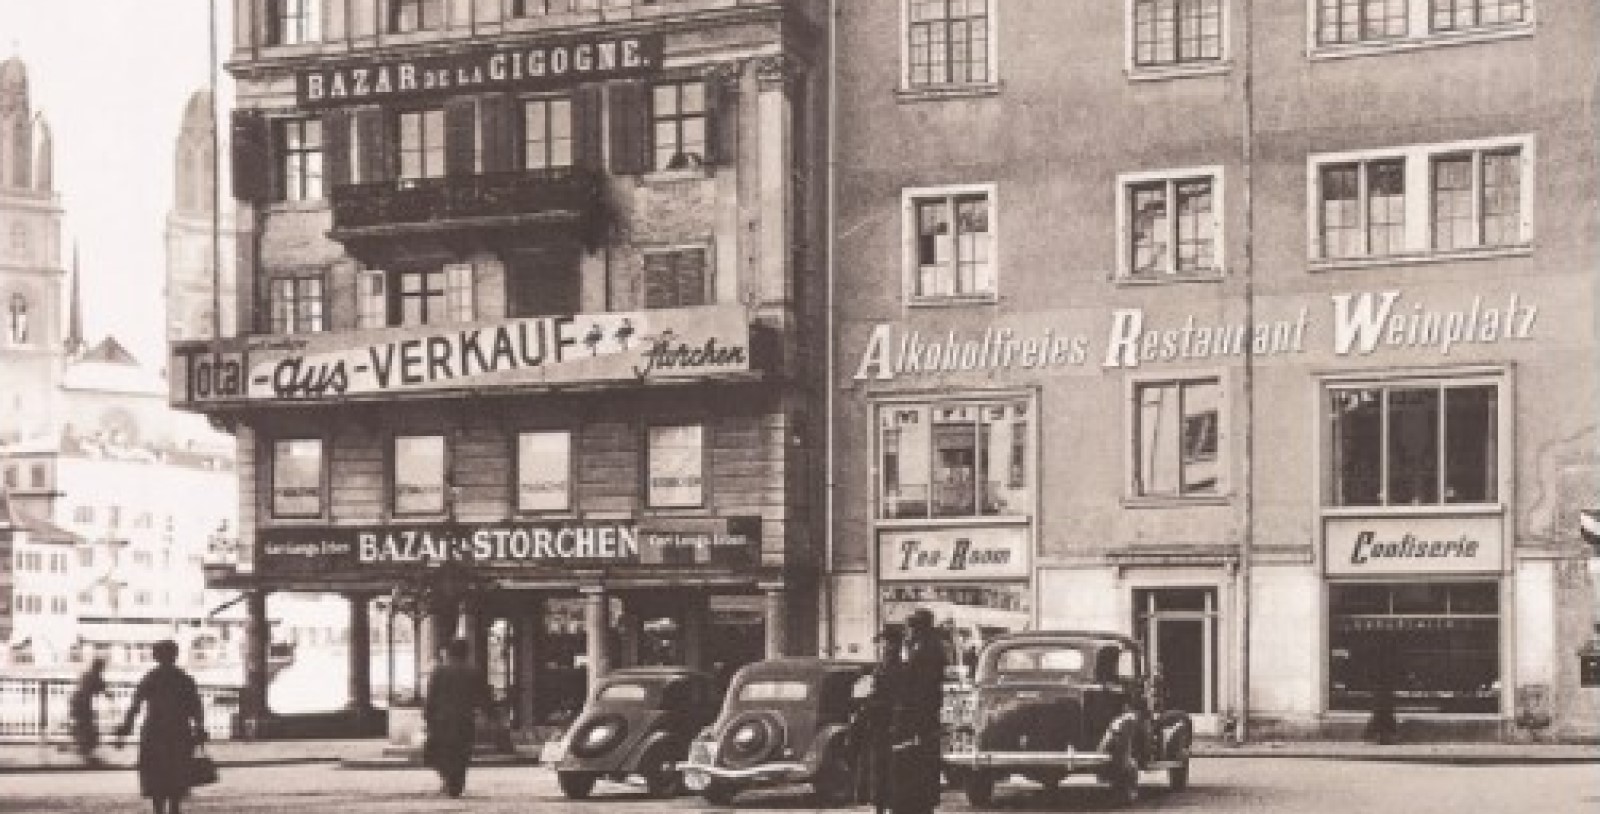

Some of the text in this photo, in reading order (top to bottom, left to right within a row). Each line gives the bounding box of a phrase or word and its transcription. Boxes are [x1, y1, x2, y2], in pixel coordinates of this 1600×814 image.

[307, 62, 418, 99] BAZAR
[423, 67, 450, 90] DE
[458, 65, 484, 87] LA
[853, 289, 1537, 380] Alkoholfreies Restaurant Weinplatz
[474, 527, 639, 561] STORCHEN
[1350, 530, 1480, 565] Confiserie
